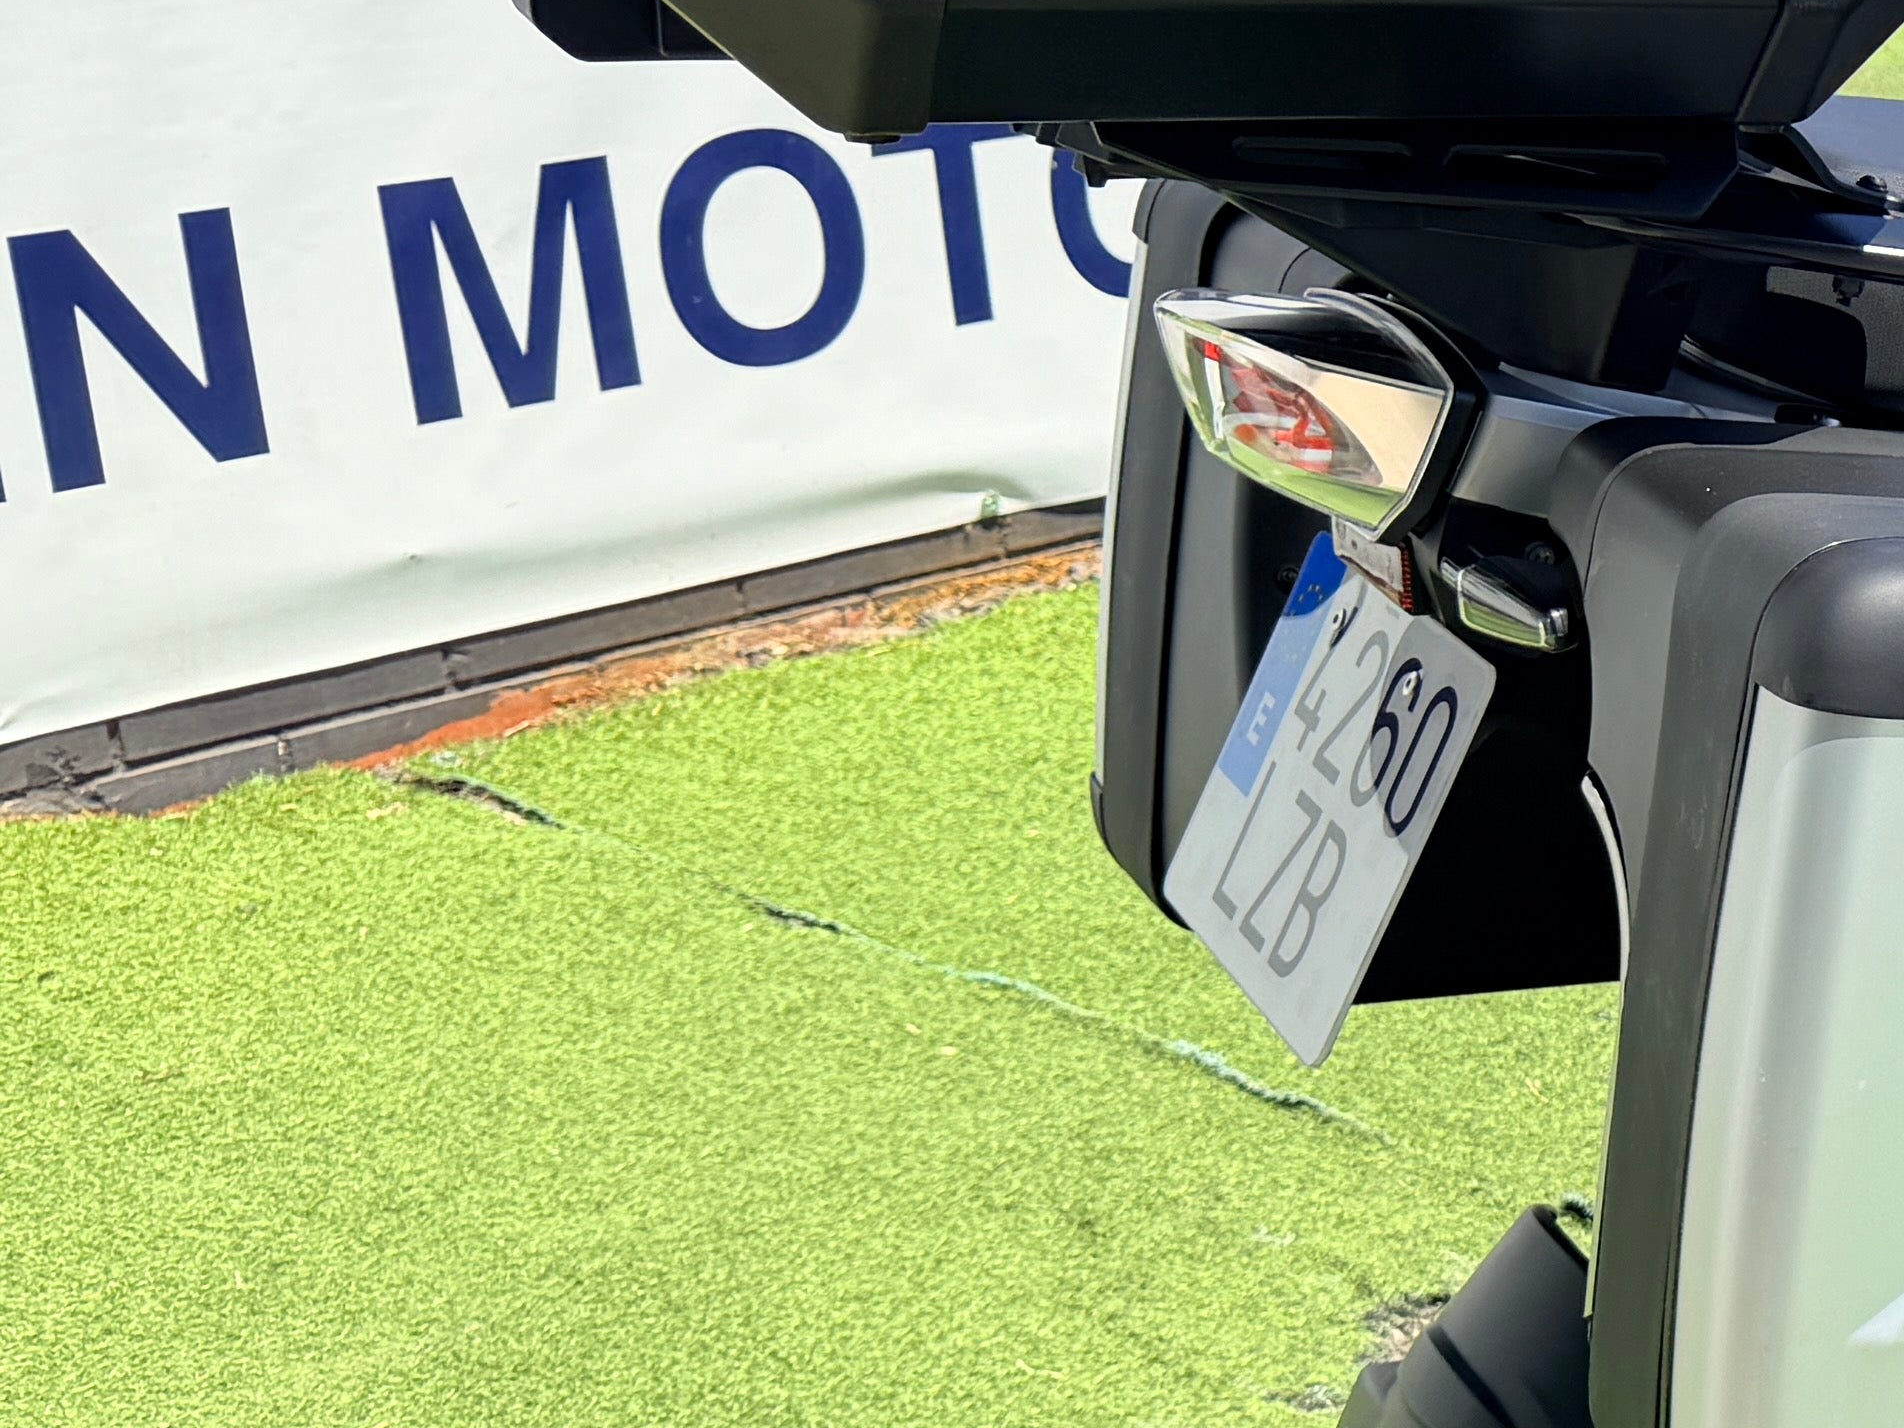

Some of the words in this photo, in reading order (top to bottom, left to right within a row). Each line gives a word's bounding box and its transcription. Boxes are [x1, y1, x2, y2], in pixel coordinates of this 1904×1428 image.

[0, 207, 271, 502] N
[1293, 590, 1458, 838] 4260
[1212, 759, 1347, 979] LZB
